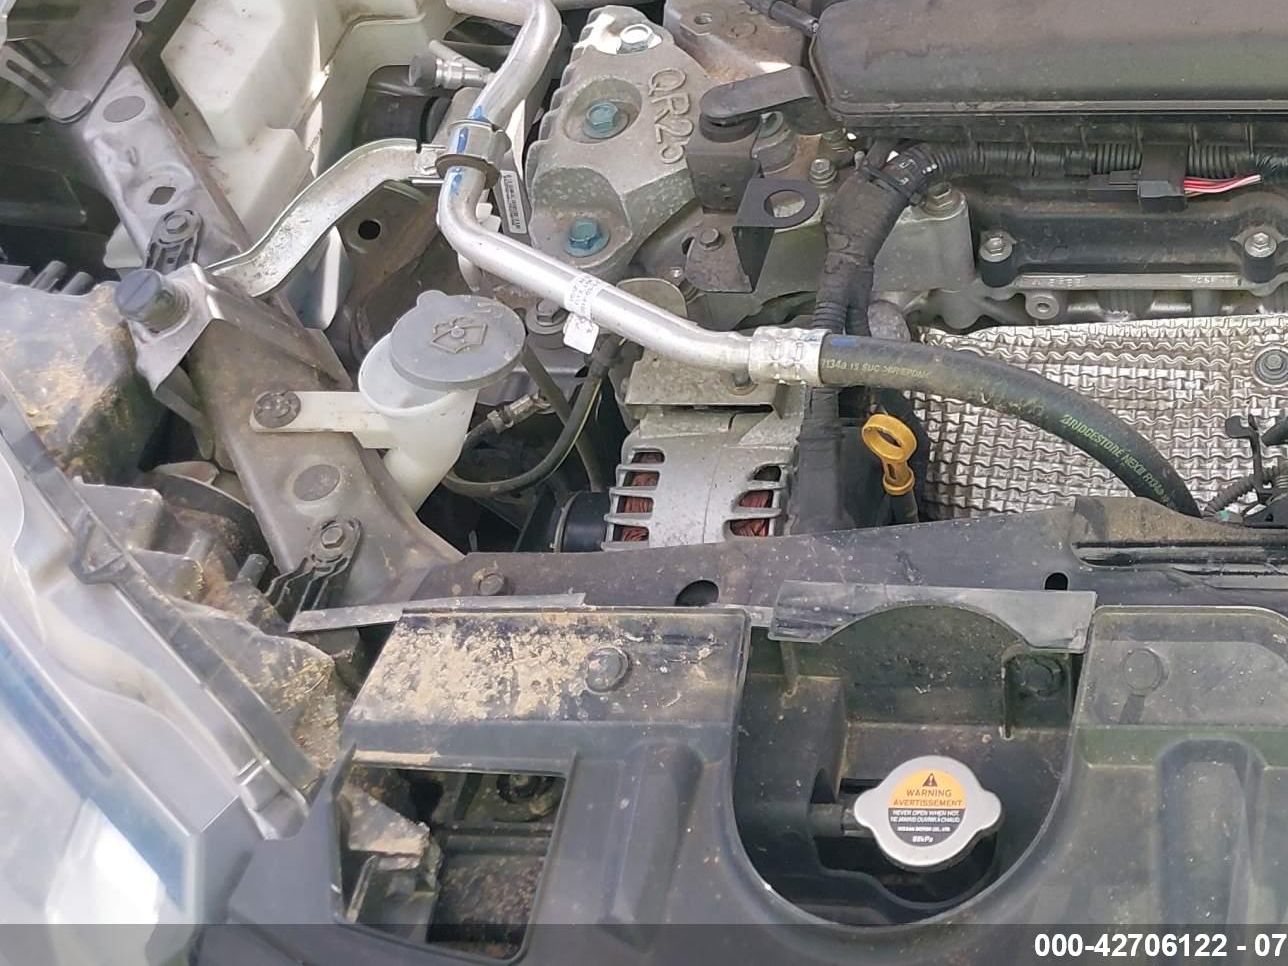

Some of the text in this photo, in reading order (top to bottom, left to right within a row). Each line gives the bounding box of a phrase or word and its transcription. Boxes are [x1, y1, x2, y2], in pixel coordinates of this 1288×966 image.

[648, 68, 694, 164] QR25
[1060, 414, 1125, 457] BRIDGESTONE
[893, 799, 963, 807] AVERTISSEMENT
[906, 789, 952, 798] WARNING
